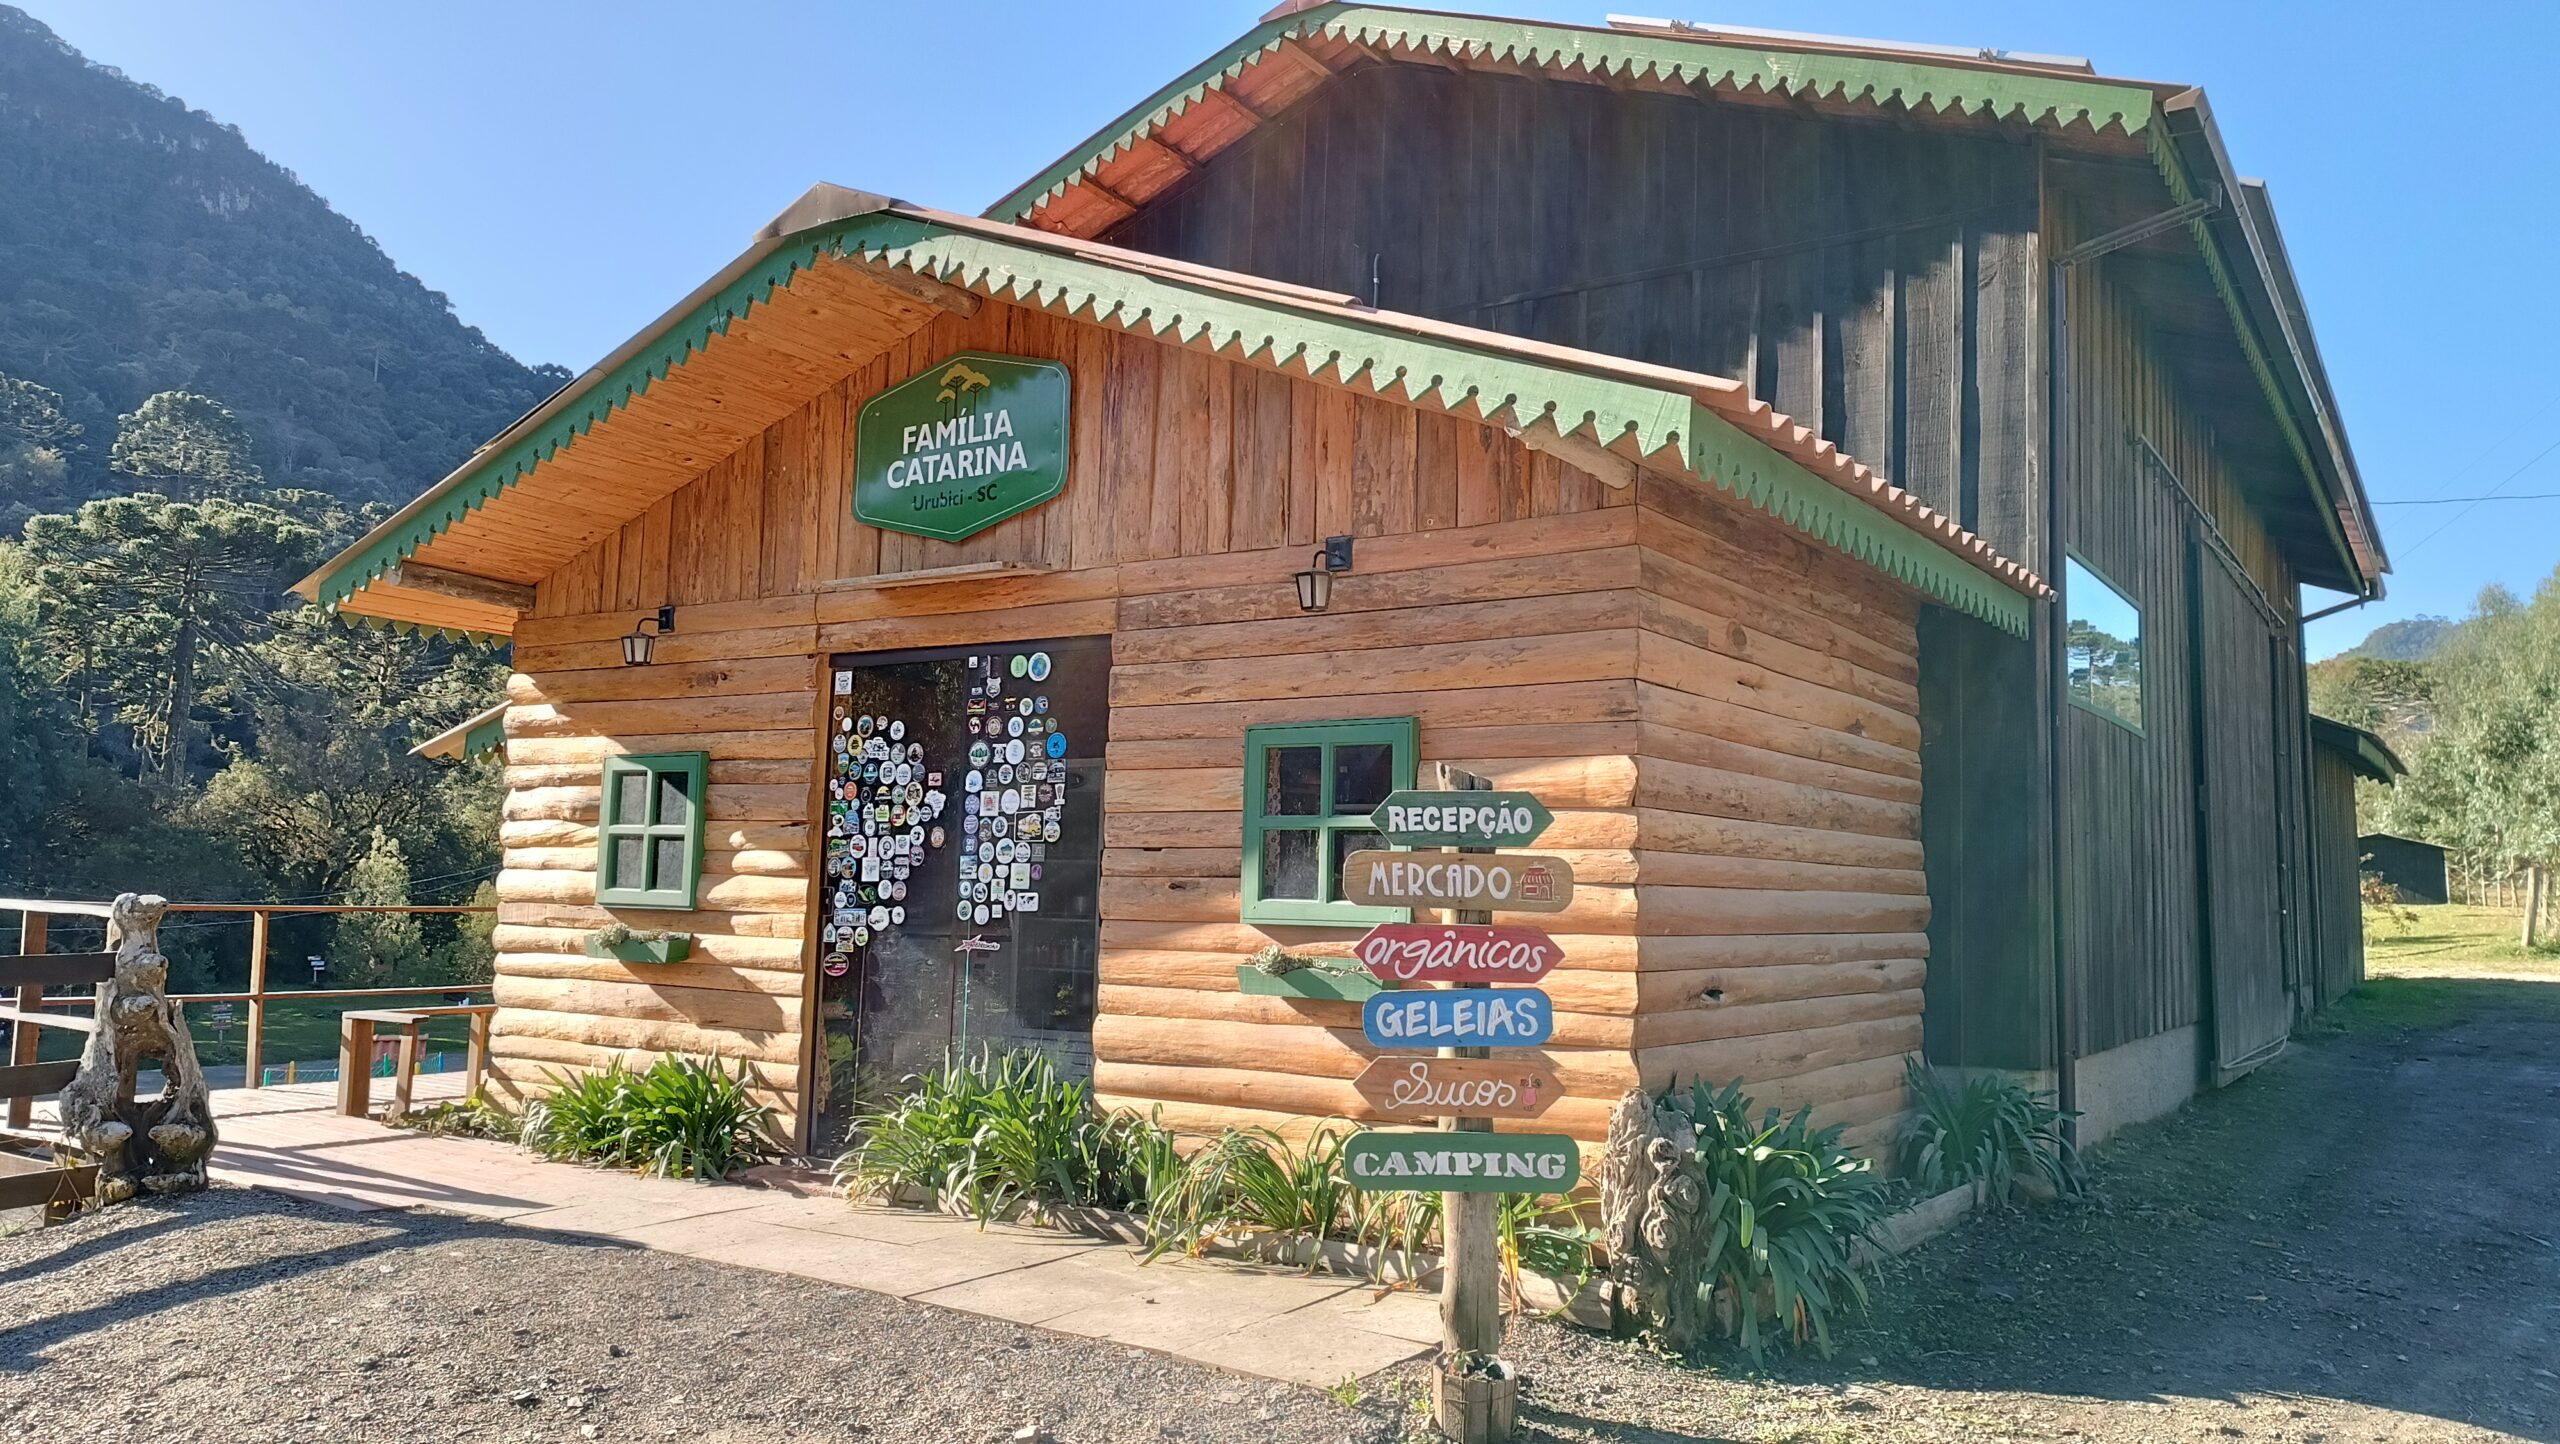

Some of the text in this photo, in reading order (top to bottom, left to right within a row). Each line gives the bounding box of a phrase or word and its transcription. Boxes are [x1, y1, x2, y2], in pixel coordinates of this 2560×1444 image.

[902, 407, 1014, 455] FAMÍLIA
[886, 440, 1028, 489] CATARINA
[912, 489, 964, 511] Urubici
[976, 484, 998, 503] SC
[1387, 800, 1533, 839] RECEPÇÃO
[1368, 861, 1512, 900] MERCADO
[1364, 930, 1547, 979] orgânicos
[1375, 997, 1539, 1038] GELEIAS
[1385, 1061, 1517, 1110] Sucos
[1353, 1151, 1566, 1180] CAMPING
